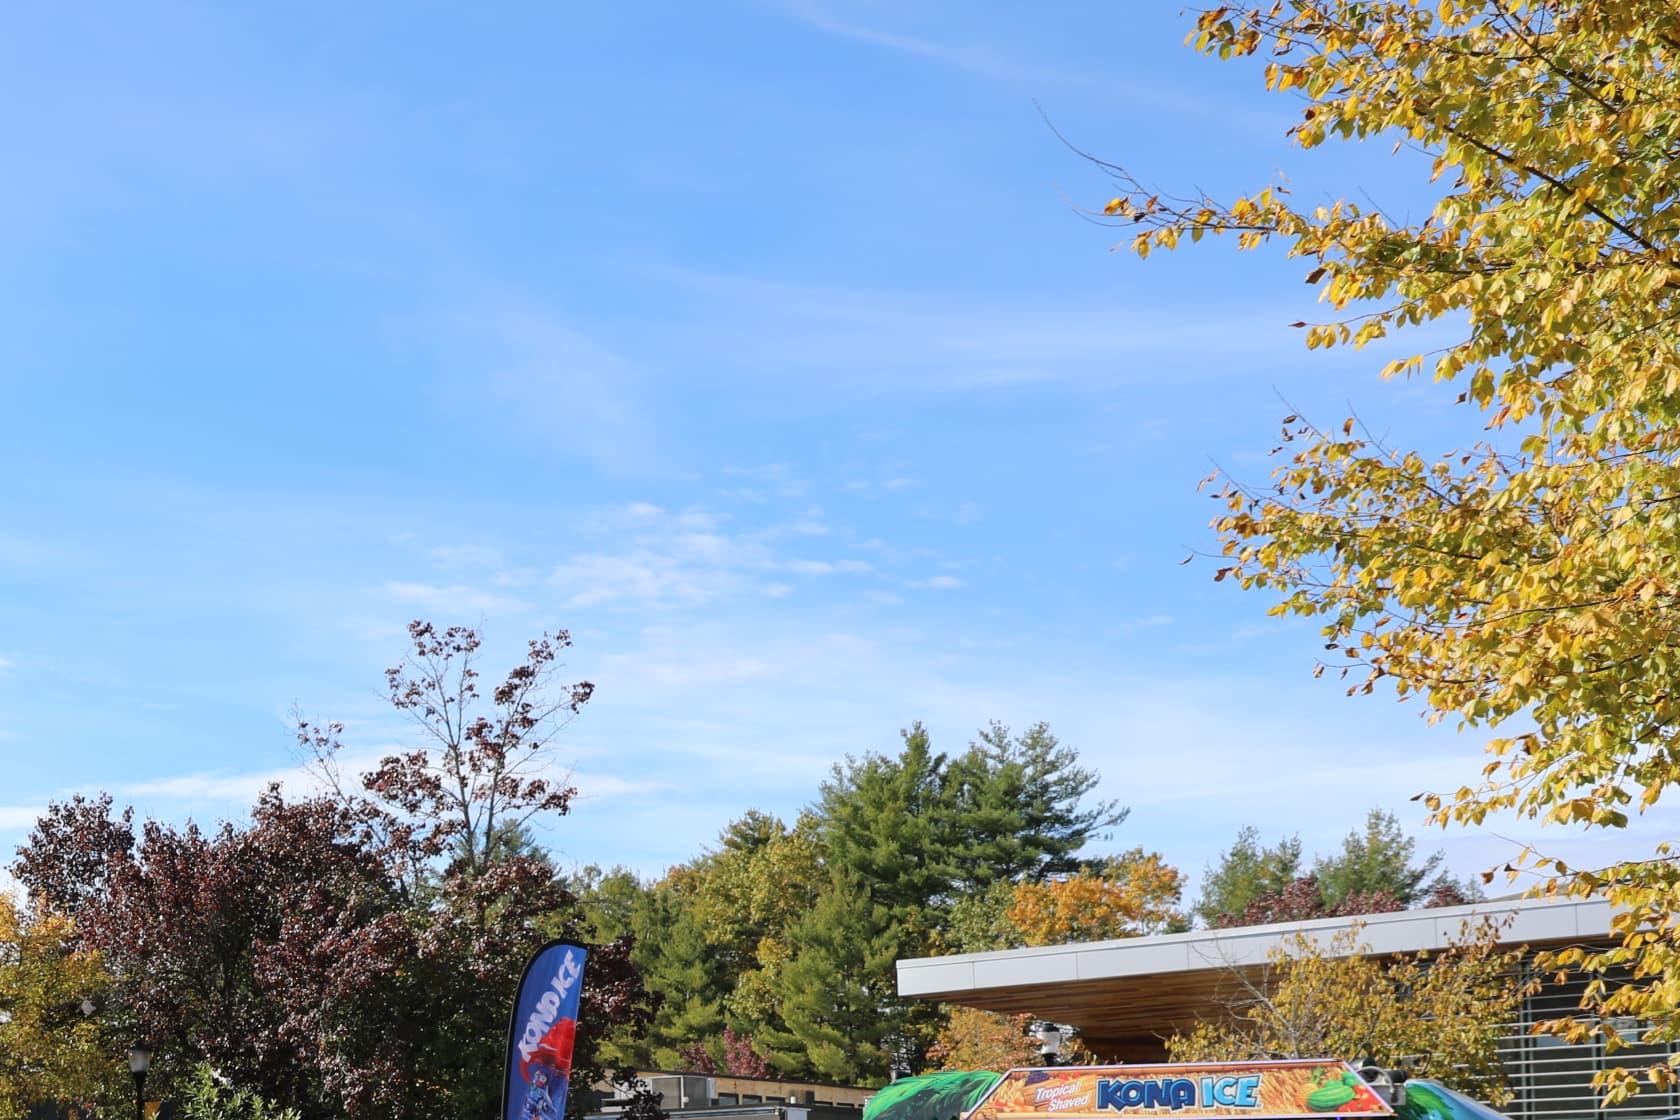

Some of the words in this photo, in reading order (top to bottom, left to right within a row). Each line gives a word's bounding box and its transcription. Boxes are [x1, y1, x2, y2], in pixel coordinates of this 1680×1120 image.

[518, 991, 560, 1063] KONA
[551, 949, 581, 999] ICE
[1035, 1082, 1081, 1101] Tropical
[1047, 1094, 1090, 1112] Shaved
[1097, 1078, 1196, 1110] KONA
[1199, 1074, 1263, 1109] ICE
